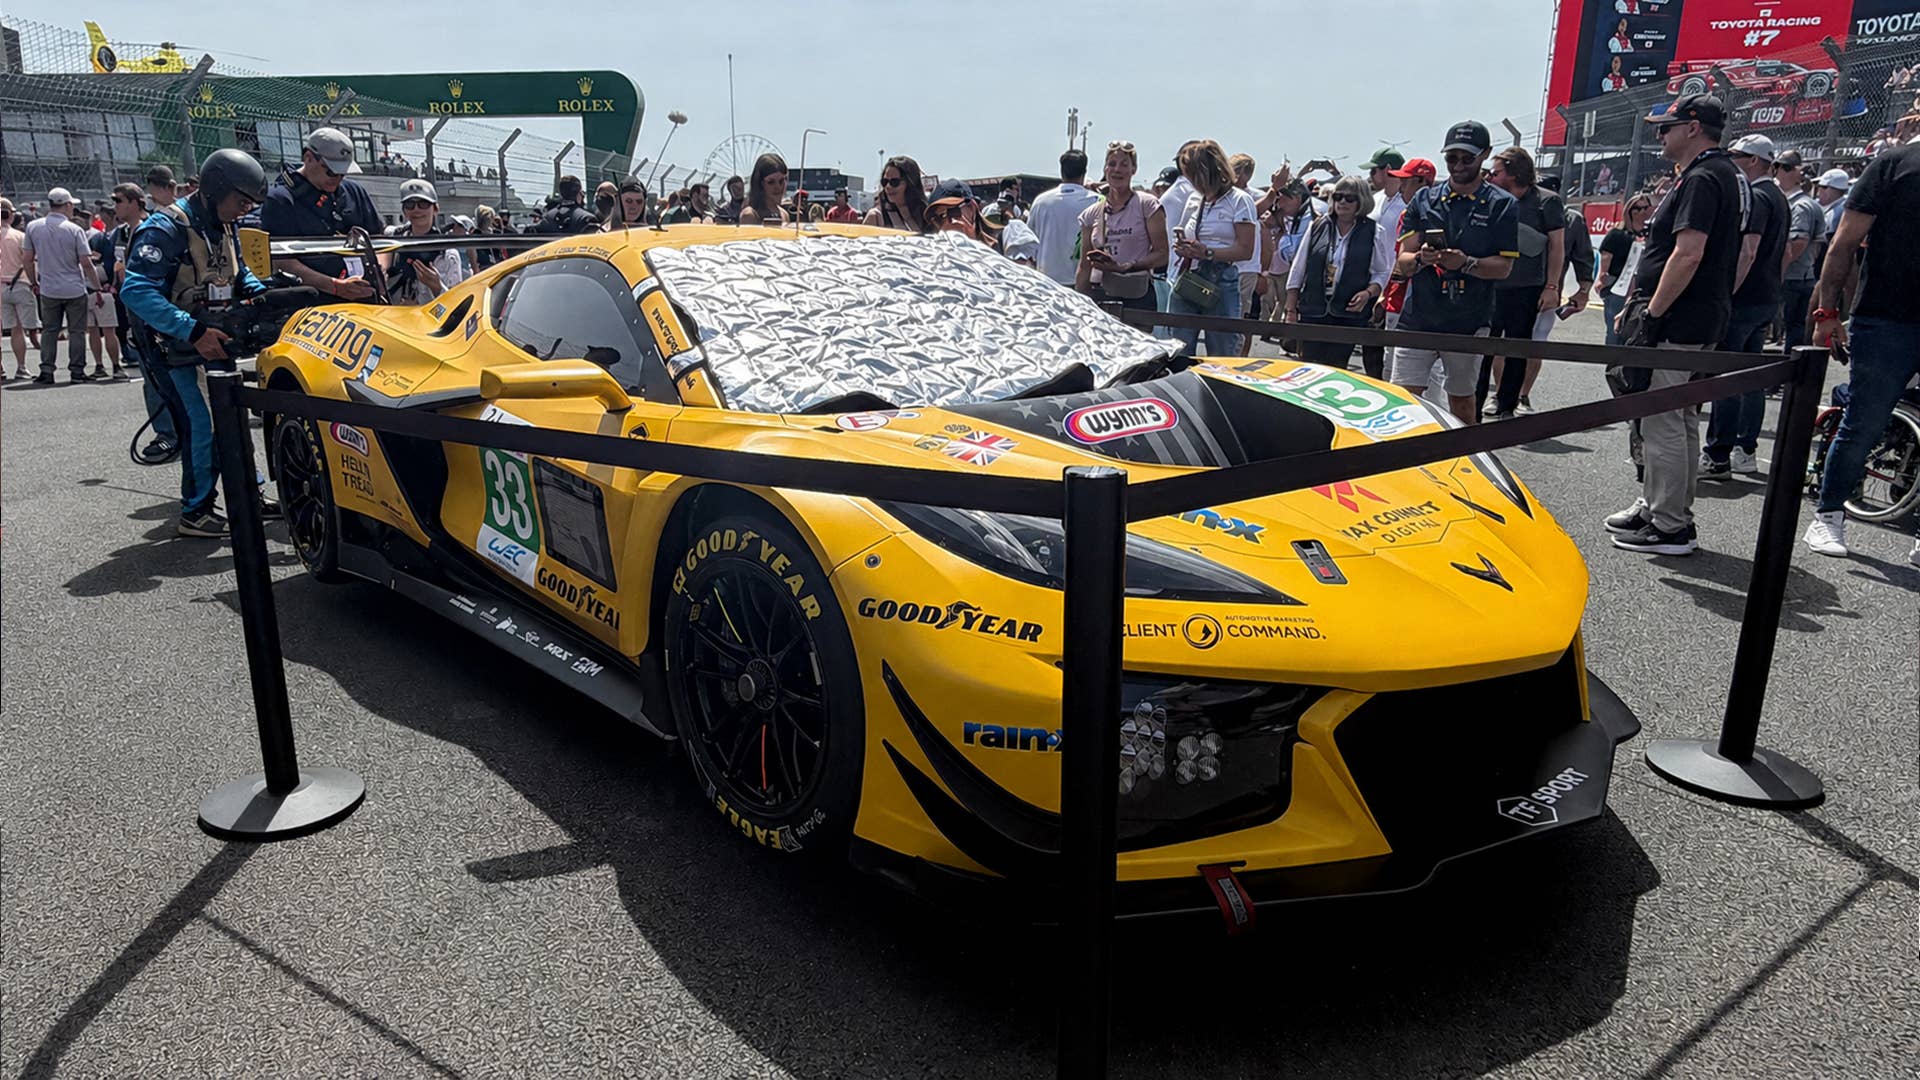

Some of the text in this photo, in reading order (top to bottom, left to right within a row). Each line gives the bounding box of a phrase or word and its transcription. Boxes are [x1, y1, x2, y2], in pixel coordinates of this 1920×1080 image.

[1710, 16, 1821, 29] TOYOTA RACING
[1857, 11, 1920, 36] TOYOTA
[1743, 29, 1780, 47] #7
[430, 101, 485, 114] ROLEX
[559, 99, 615, 112] ROLEX
[485, 449, 533, 540] 33
[488, 537, 526, 566] WEC
[1508, 767, 1589, 820] TF SPORT
[716, 794, 782, 849] EAGLE
